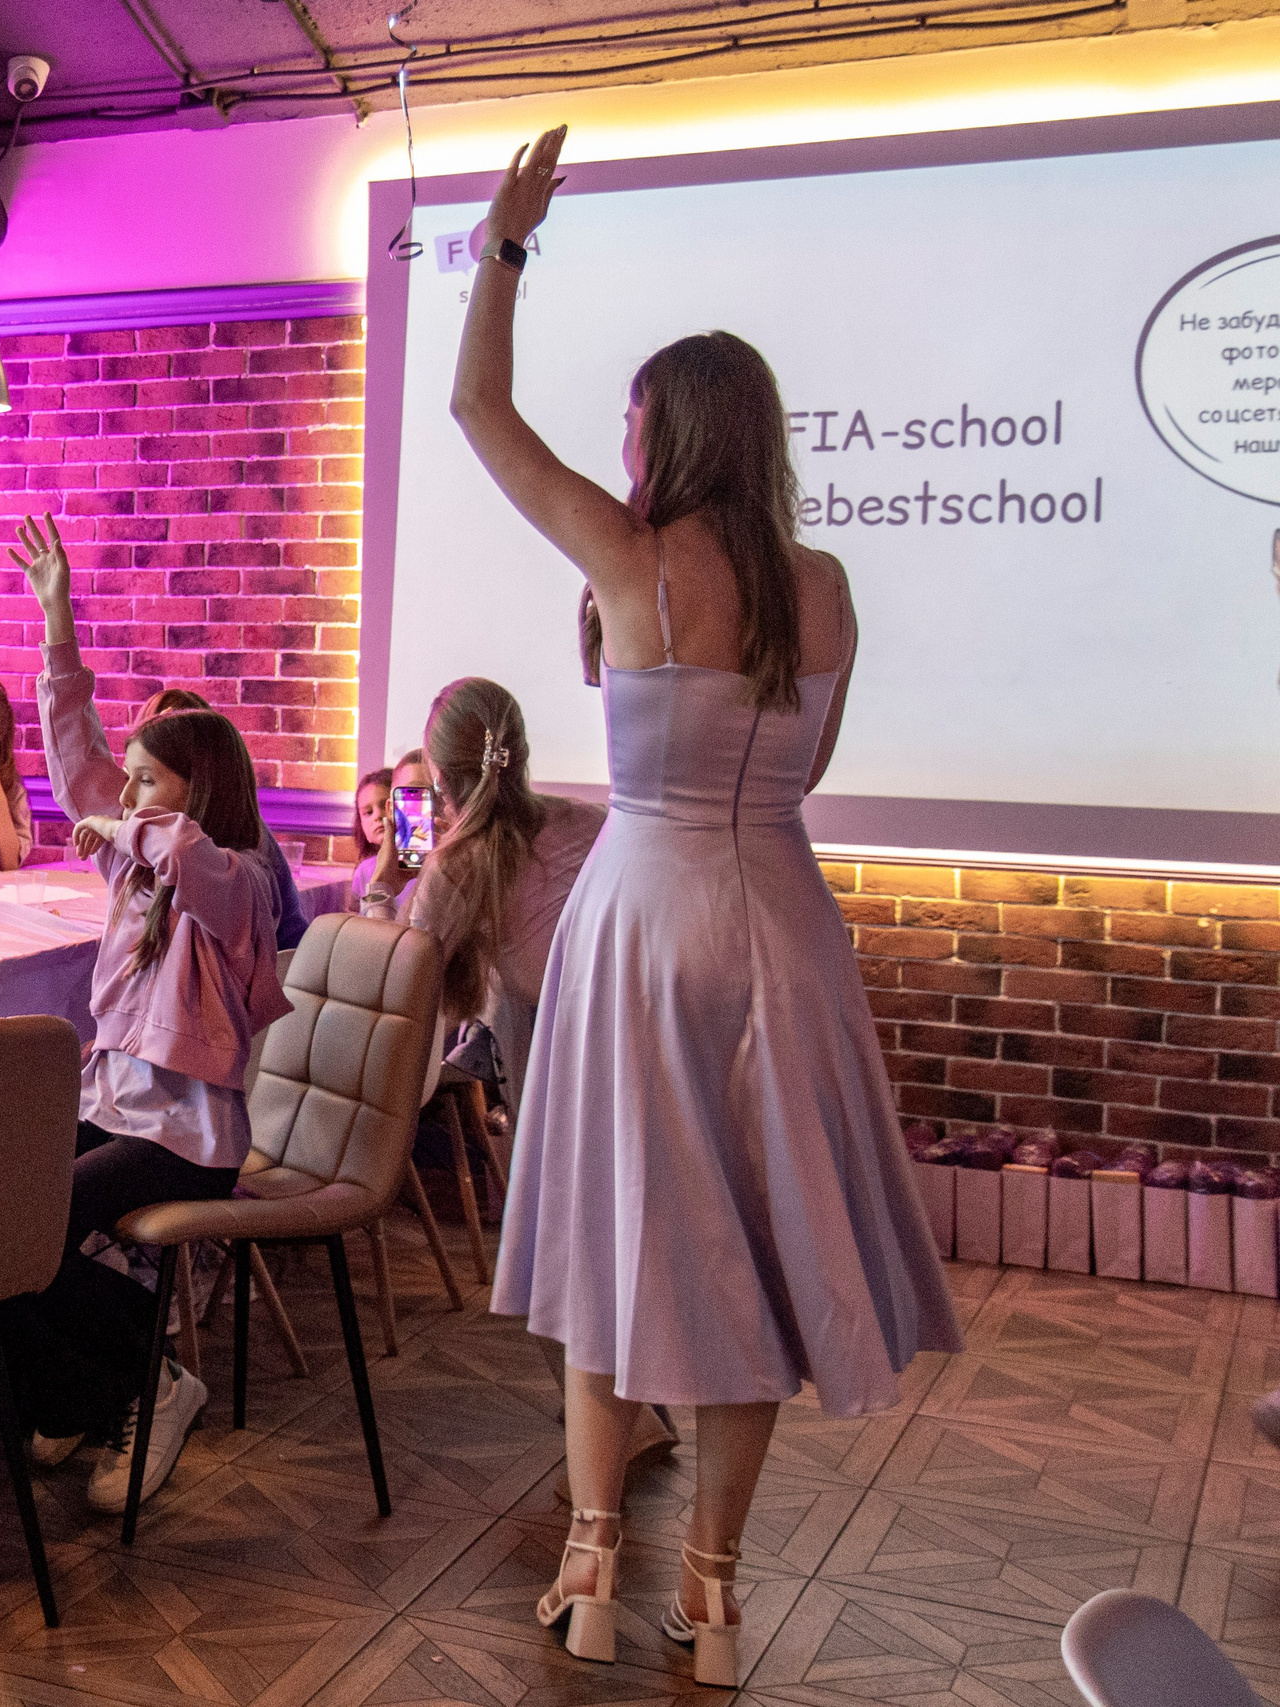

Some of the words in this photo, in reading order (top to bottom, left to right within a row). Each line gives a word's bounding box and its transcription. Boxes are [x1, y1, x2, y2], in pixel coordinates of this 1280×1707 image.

[1180, 314, 1211, 331] Не
[1233, 375, 1280, 396] мер
[1199, 406, 1280, 425] соцсет
